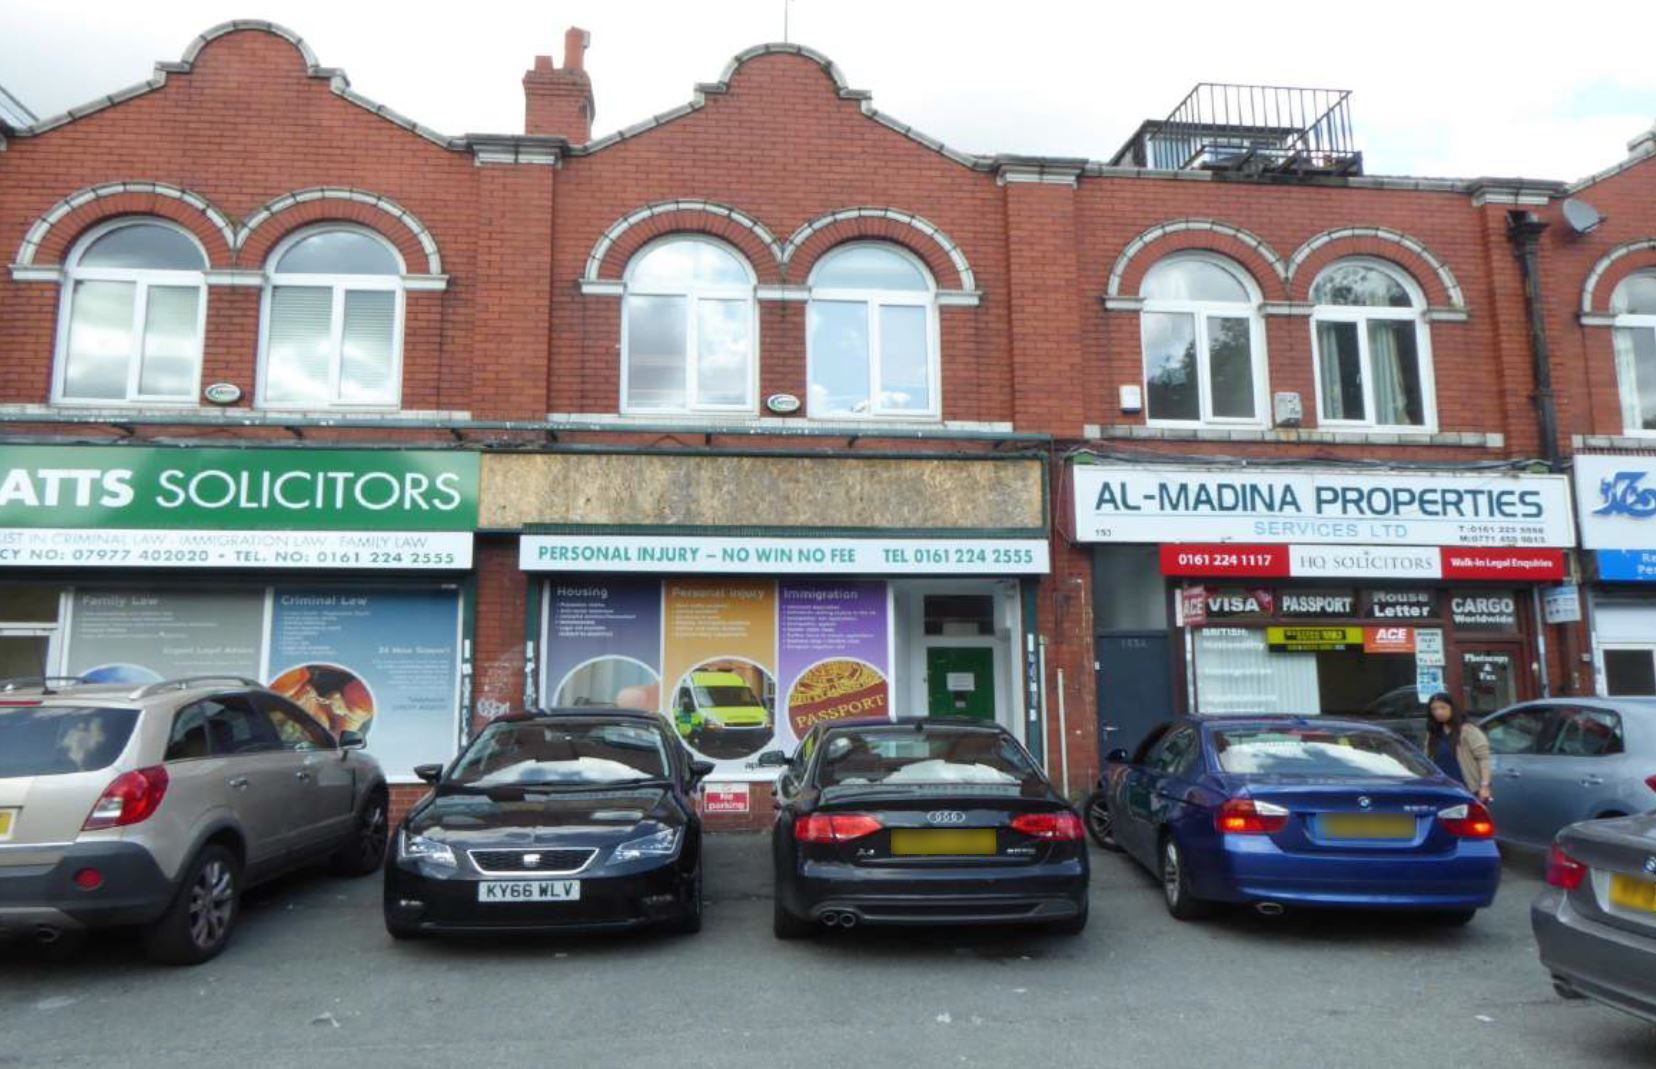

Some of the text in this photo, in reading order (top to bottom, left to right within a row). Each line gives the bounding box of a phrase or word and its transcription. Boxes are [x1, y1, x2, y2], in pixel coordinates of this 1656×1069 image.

[0, 468, 462, 511] ATTS SOLICITORS
[1095, 481, 1544, 518] AL-MADINA PROPERTIES
[1254, 521, 1408, 538] SERVICES LTD
[51, 533, 127, 545] CRIMINAL
[133, 534, 165, 546] LAW
[179, 534, 289, 547] IMMIGRATION
[294, 535, 328, 547] LAW
[340, 536, 390, 548] FAMILY
[395, 536, 428, 548] LAW
[30, 549, 65, 561] NO:
[72, 550, 131, 561] 07977
[138, 550, 209, 561] 402020
[235, 551, 267, 563] TEL.
[275, 551, 309, 563] NO:
[317, 552, 360, 563] 0161
[368, 552, 402, 563] 224
[410, 552, 454, 563] 2555
[538, 546, 631, 561] PERSONAL
[637, 546, 700, 562] INJURY
[722, 547, 750, 562] NO
[756, 548, 793, 562] WIN
[797, 548, 826, 562] NO
[831, 548, 856, 563] FEE
[883, 549, 909, 563] TEL
[914, 549, 950, 563] 0161
[955, 549, 987, 563] 224
[992, 549, 1033, 563] 2555
[1178, 554, 1272, 566] 0161 224 1117
[1300, 554, 1433, 571] HQ SOLICITORS
[1487, 558, 1510, 568] Legal
[1512, 558, 1553, 569] Enquiries
[557, 586, 608, 599] Housing
[672, 587, 726, 598] Personal
[783, 588, 858, 600] Immigration
[82, 594, 159, 608] Family Law
[281, 595, 368, 606] Criminal Law
[1208, 597, 1260, 611] VISA
[1282, 596, 1352, 612] PASSPORT
[1451, 598, 1514, 613] CARGO
[1374, 605, 1430, 617] Letter
[1453, 614, 1514, 624] Worldwide
[1376, 628, 1407, 639] ACE
[795, 694, 886, 728] PASSPORT
[708, 801, 745, 810] parking
[487, 883, 573, 898] KY66 WLV
